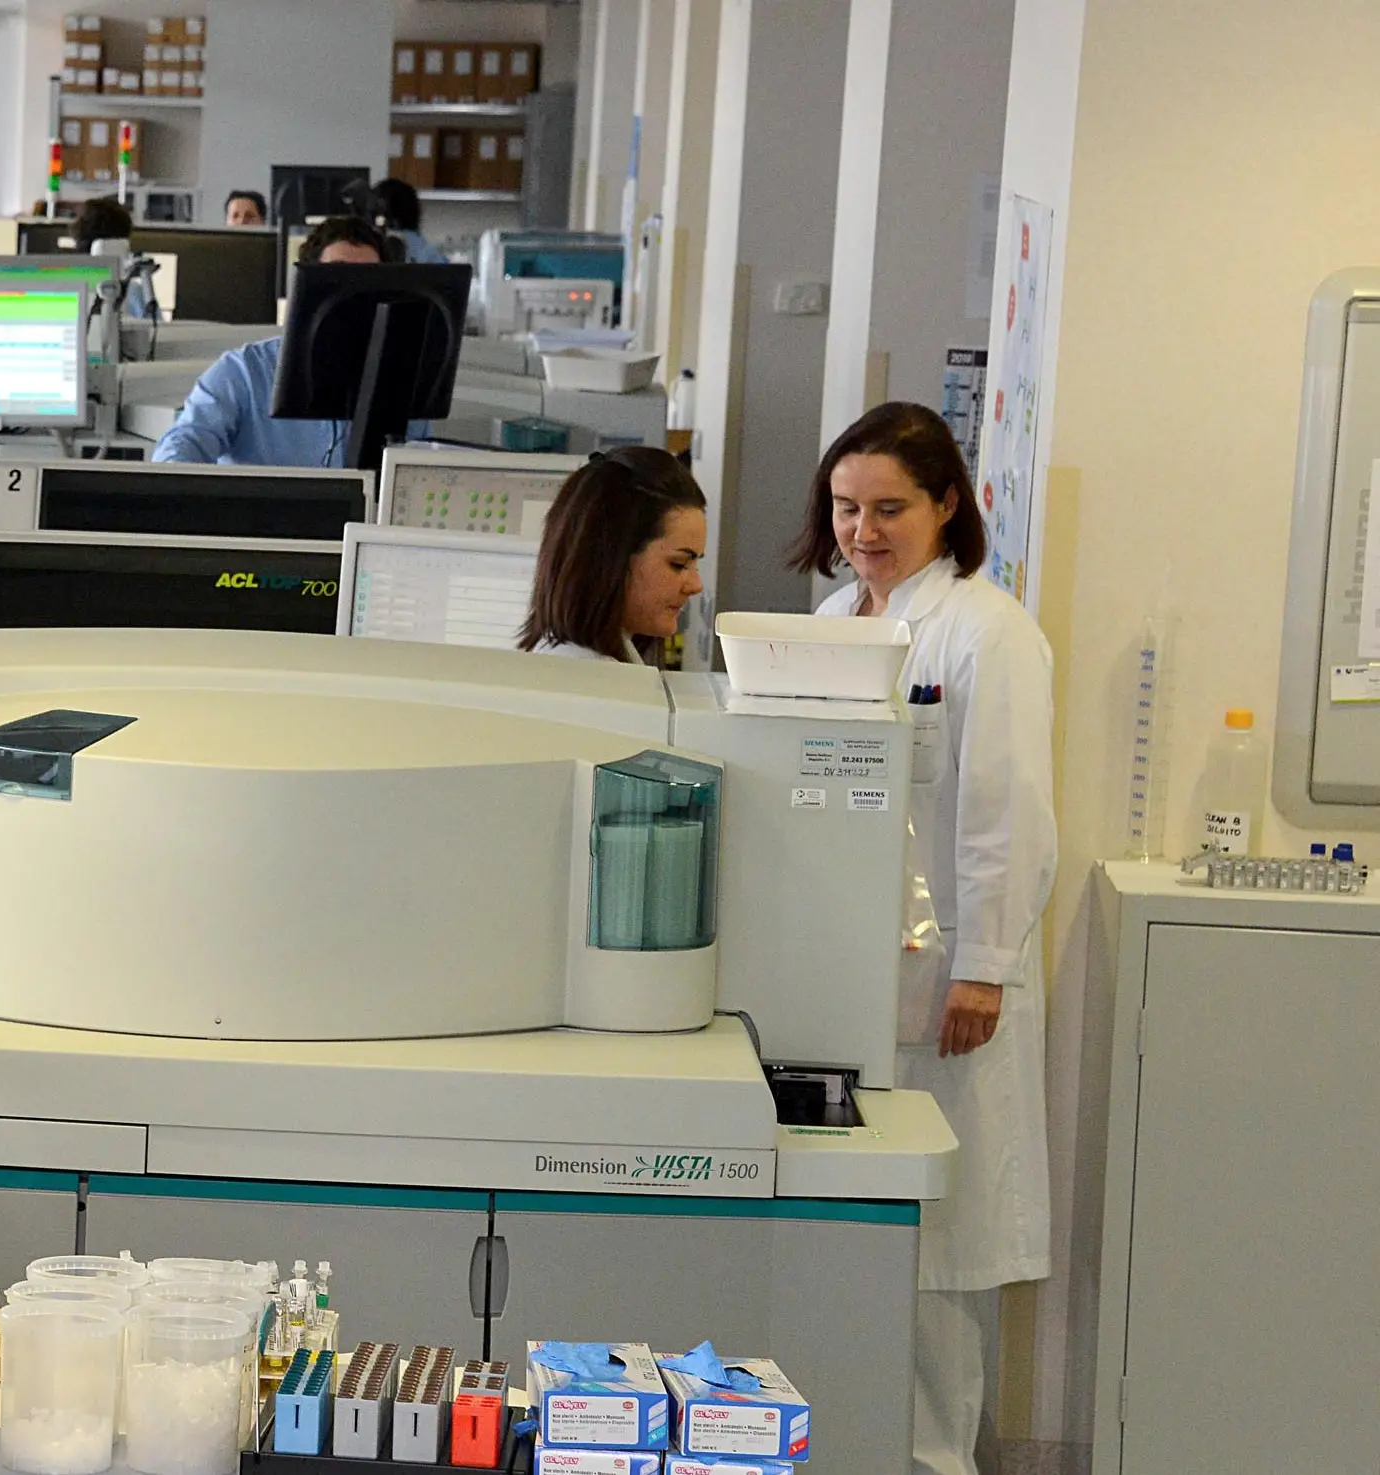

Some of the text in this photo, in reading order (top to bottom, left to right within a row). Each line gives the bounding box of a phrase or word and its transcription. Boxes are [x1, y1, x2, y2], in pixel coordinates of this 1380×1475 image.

[7, 469, 22, 492] 2
[301, 581, 337, 597] 700
[1207, 825, 1241, 836] DILUITO
[535, 1154, 759, 1180] Dimension VISTA 1500
